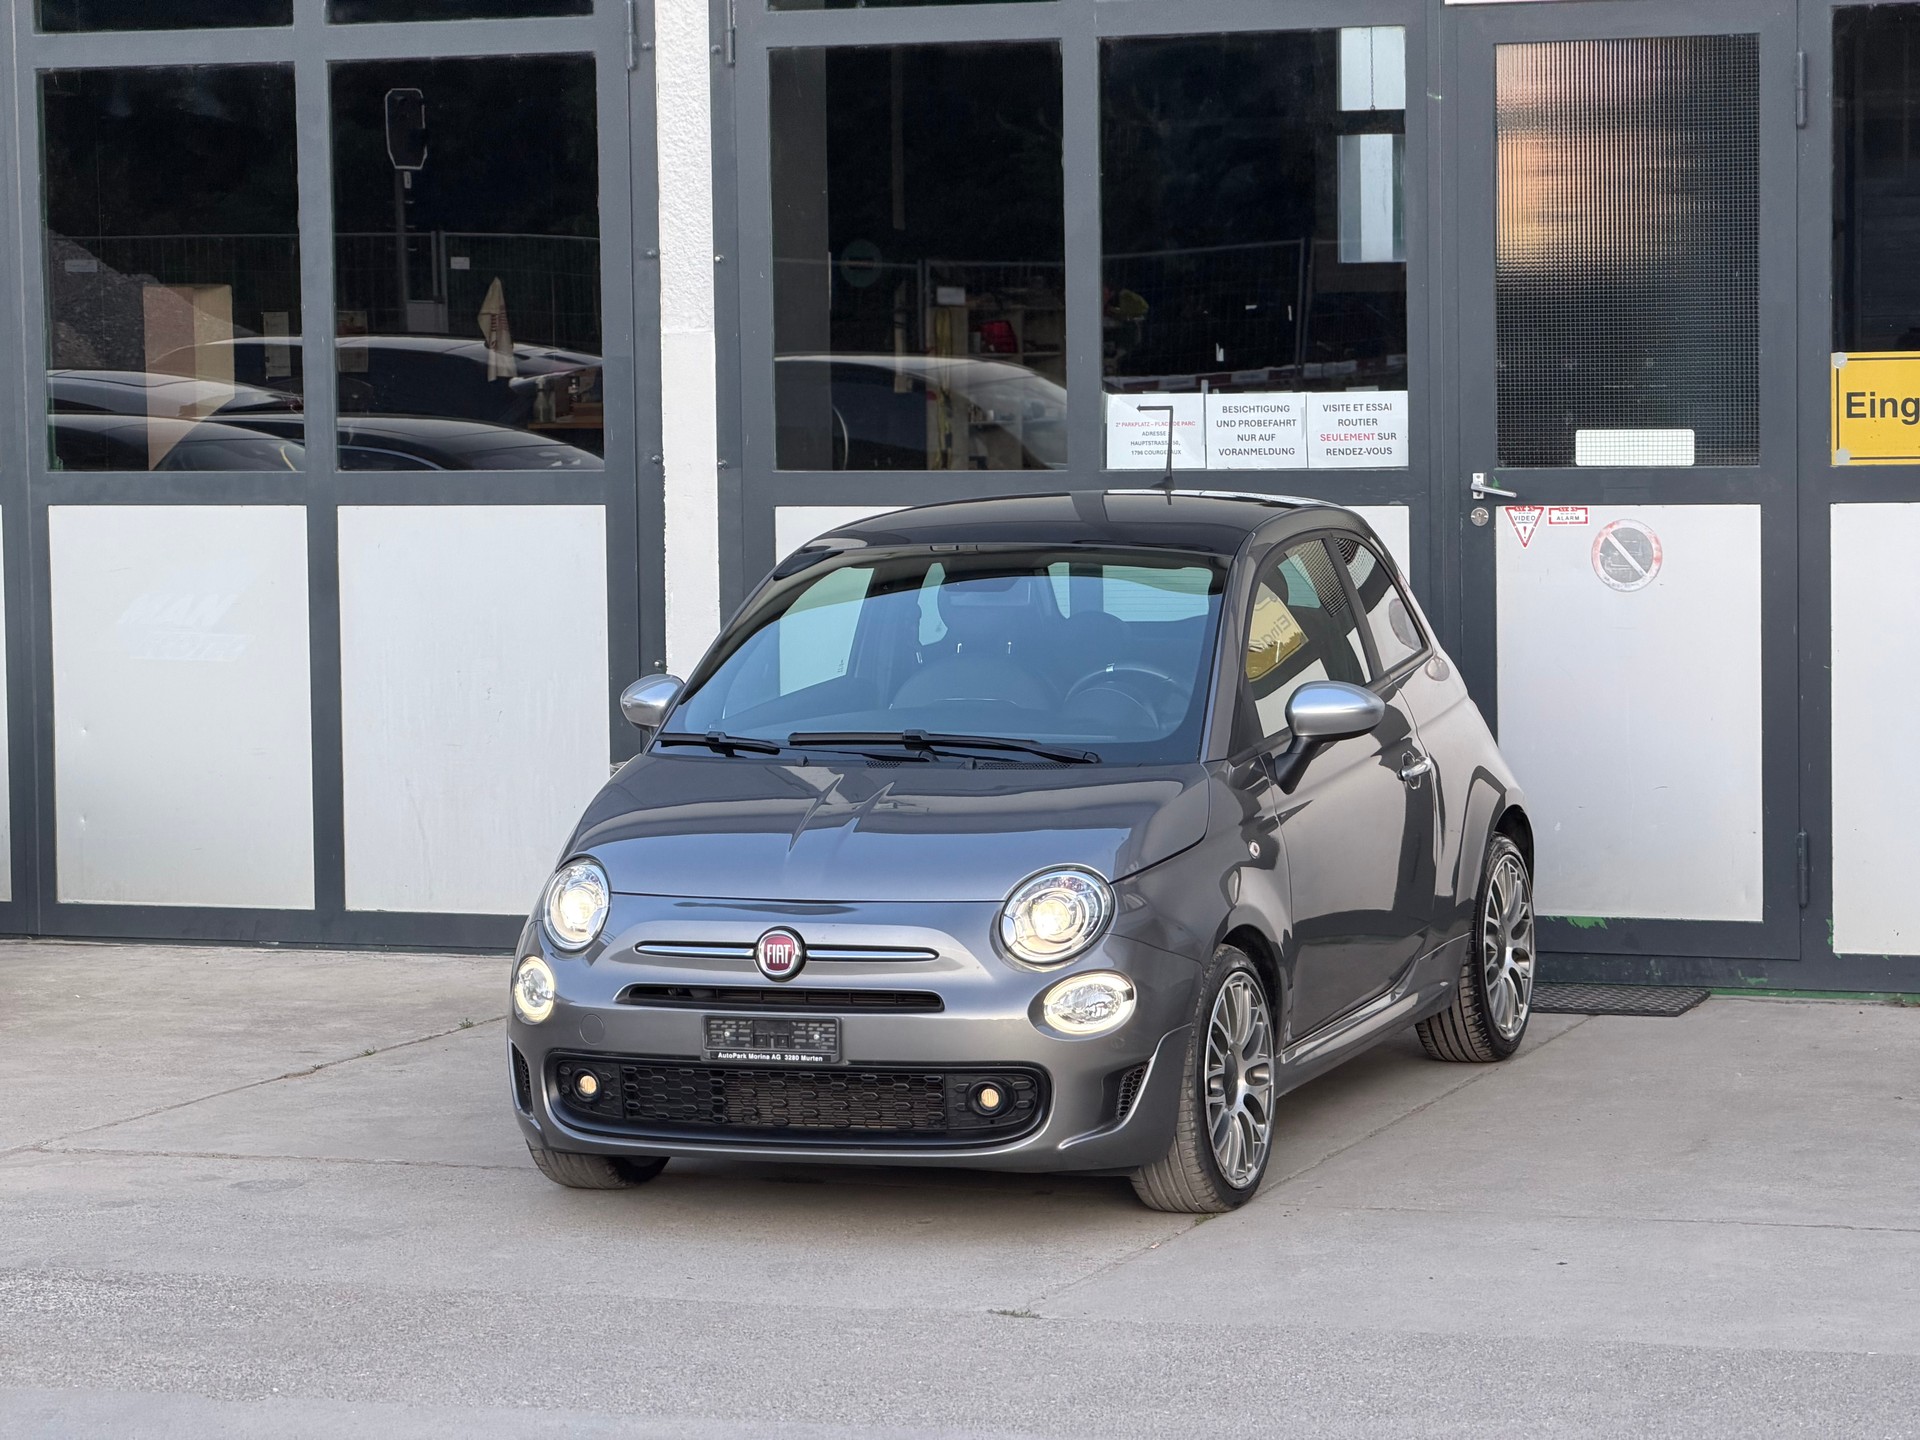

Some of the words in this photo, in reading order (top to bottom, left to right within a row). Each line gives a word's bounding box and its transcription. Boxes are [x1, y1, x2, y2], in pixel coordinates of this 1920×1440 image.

[1221, 404, 1291, 414] BESICHTIGUNG
[1322, 403, 1351, 413] VISITE
[1352, 403, 1364, 412] ET
[1365, 403, 1393, 412] ESSAI
[1216, 419, 1236, 428] UND
[1238, 418, 1297, 428] PROBEFAHRT
[1337, 417, 1378, 427] ROUTIER
[1237, 433, 1257, 442] NUR
[1258, 433, 1276, 442] AUF
[1320, 432, 1376, 442] SEULEMENT
[1377, 432, 1397, 442] SUR
[1218, 447, 1296, 457] VORANMELDUNG
[1326, 446, 1393, 457] RENDEZ-VOUS
[766, 944, 791, 964] FIAT
[800, 1054, 823, 1062] Murten
